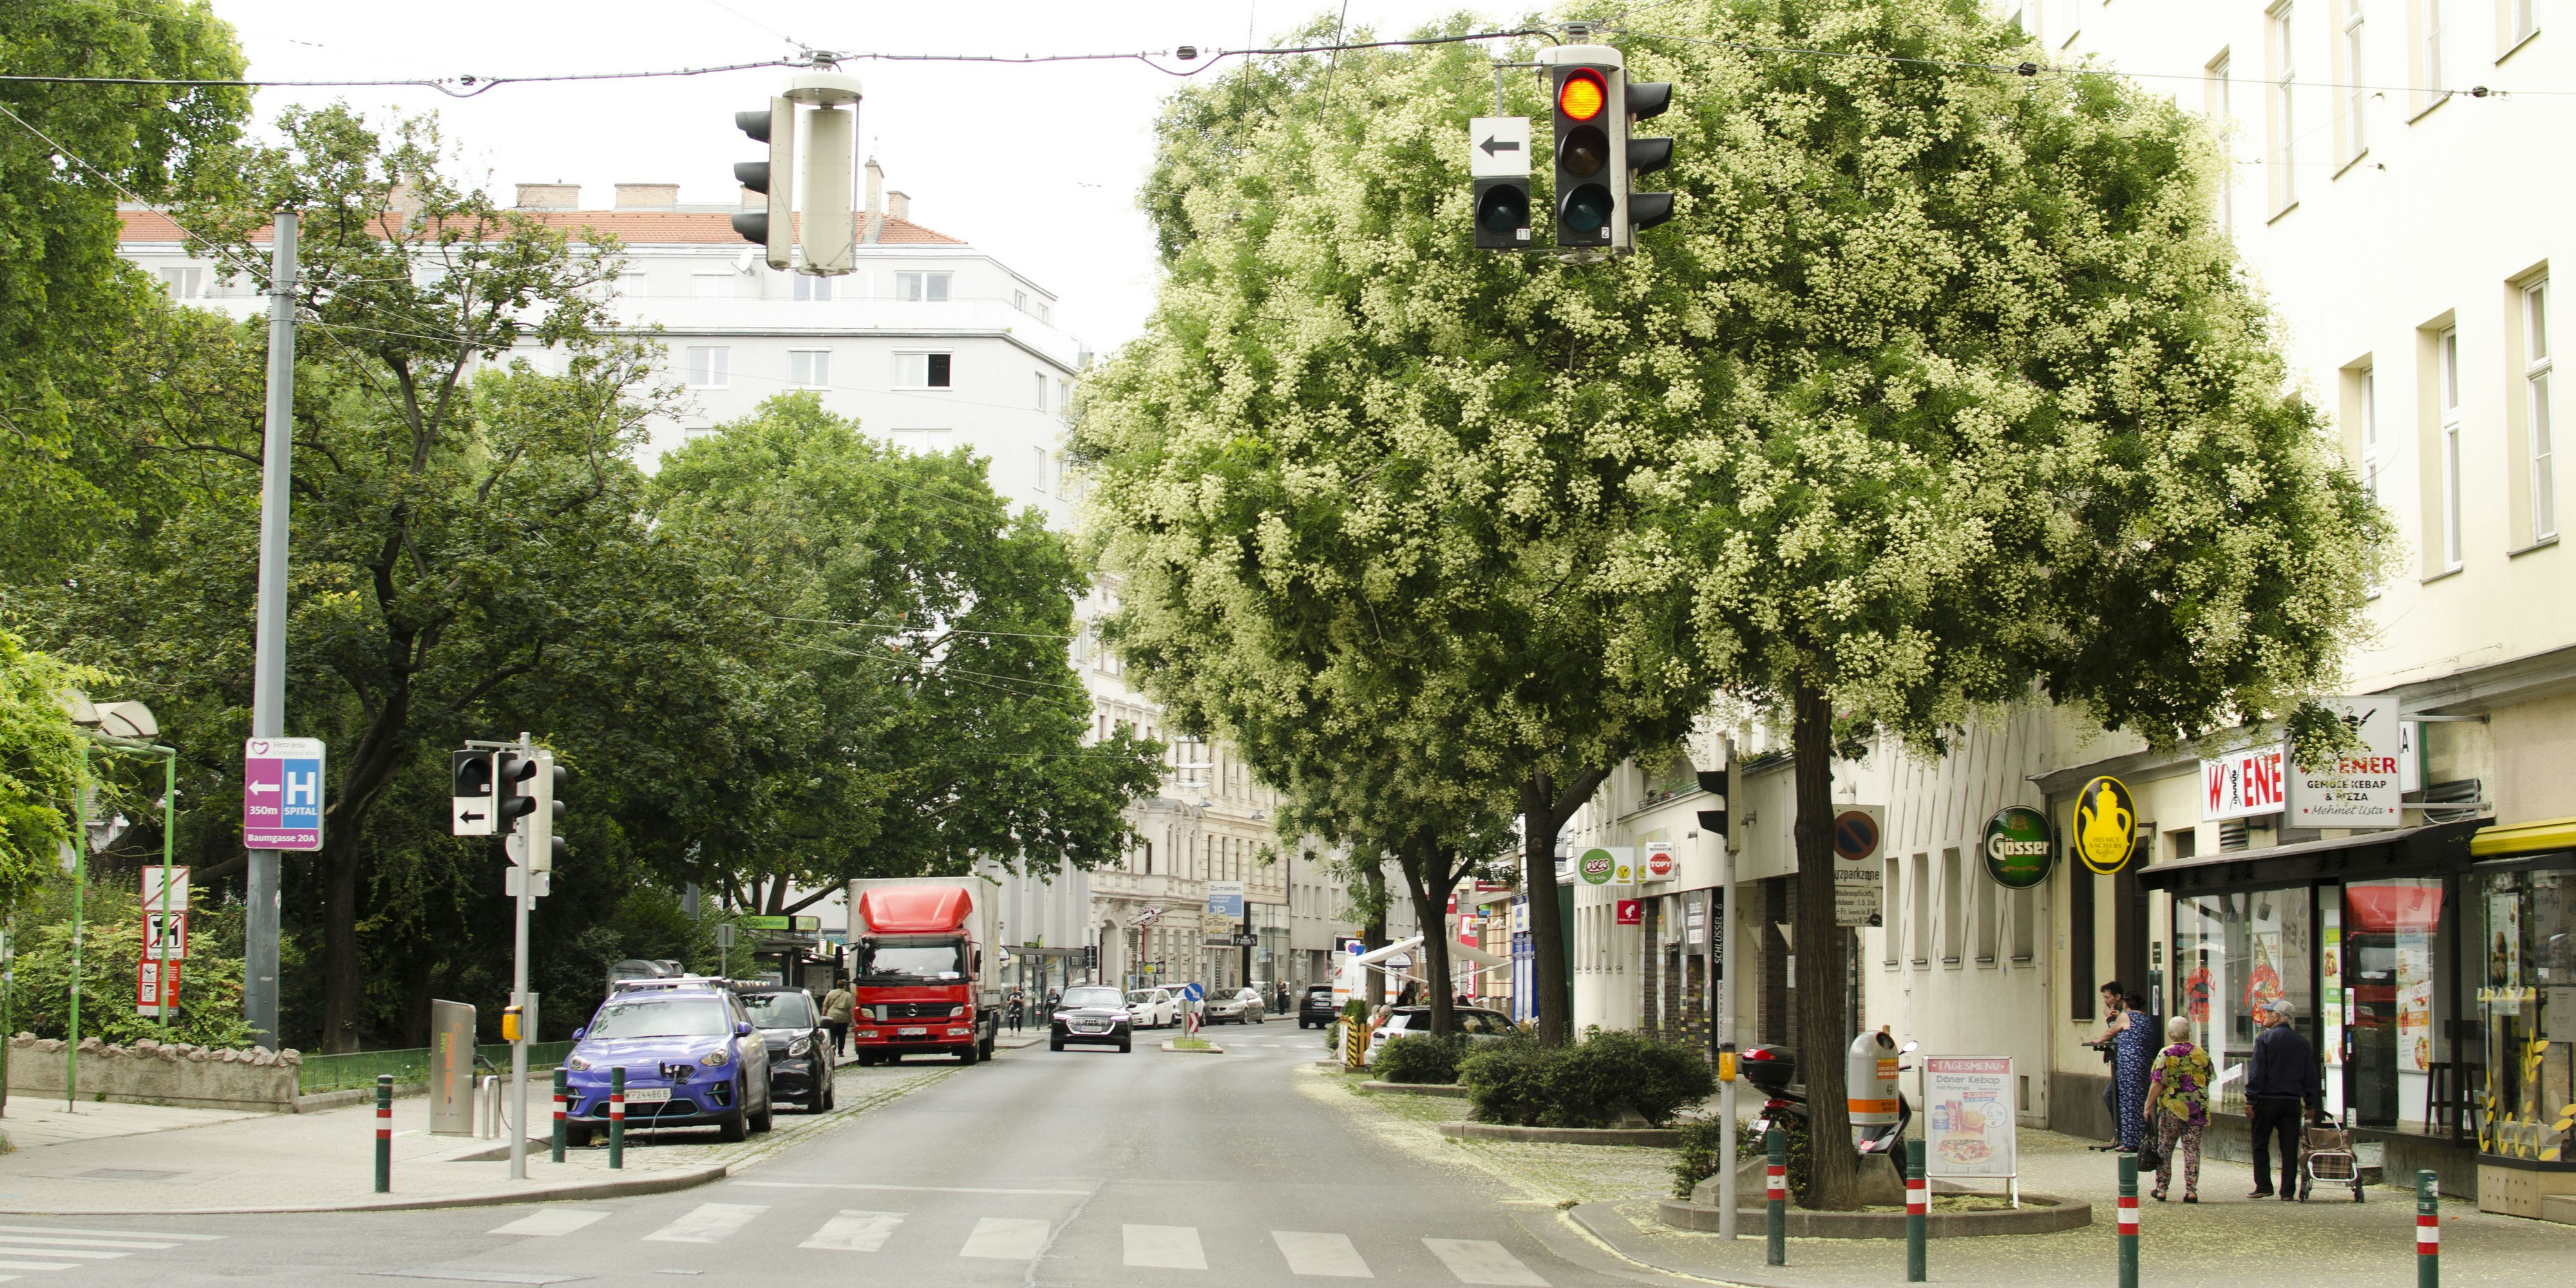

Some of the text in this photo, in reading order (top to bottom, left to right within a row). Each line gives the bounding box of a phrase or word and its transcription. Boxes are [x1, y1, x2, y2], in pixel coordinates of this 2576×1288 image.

[1519, 230, 1528, 238] 11
[1602, 229, 1608, 237] 2
[287, 772, 316, 805] H
[2351, 781, 2387, 789] KEBAP
[2325, 793, 2332, 801] &
[249, 806, 278, 815] 350m
[284, 807, 317, 815] SPITAL
[2311, 804, 2385, 815] Mehmet Usta
[247, 834, 296, 843] Baumgasse
[1988, 833, 2049, 860] Gösser
[1834, 867, 1879, 882] urzparkzone
[1714, 912, 1723, 965] SCHLÜSSEL-
[1969, 1076, 2000, 1085] Kebap
